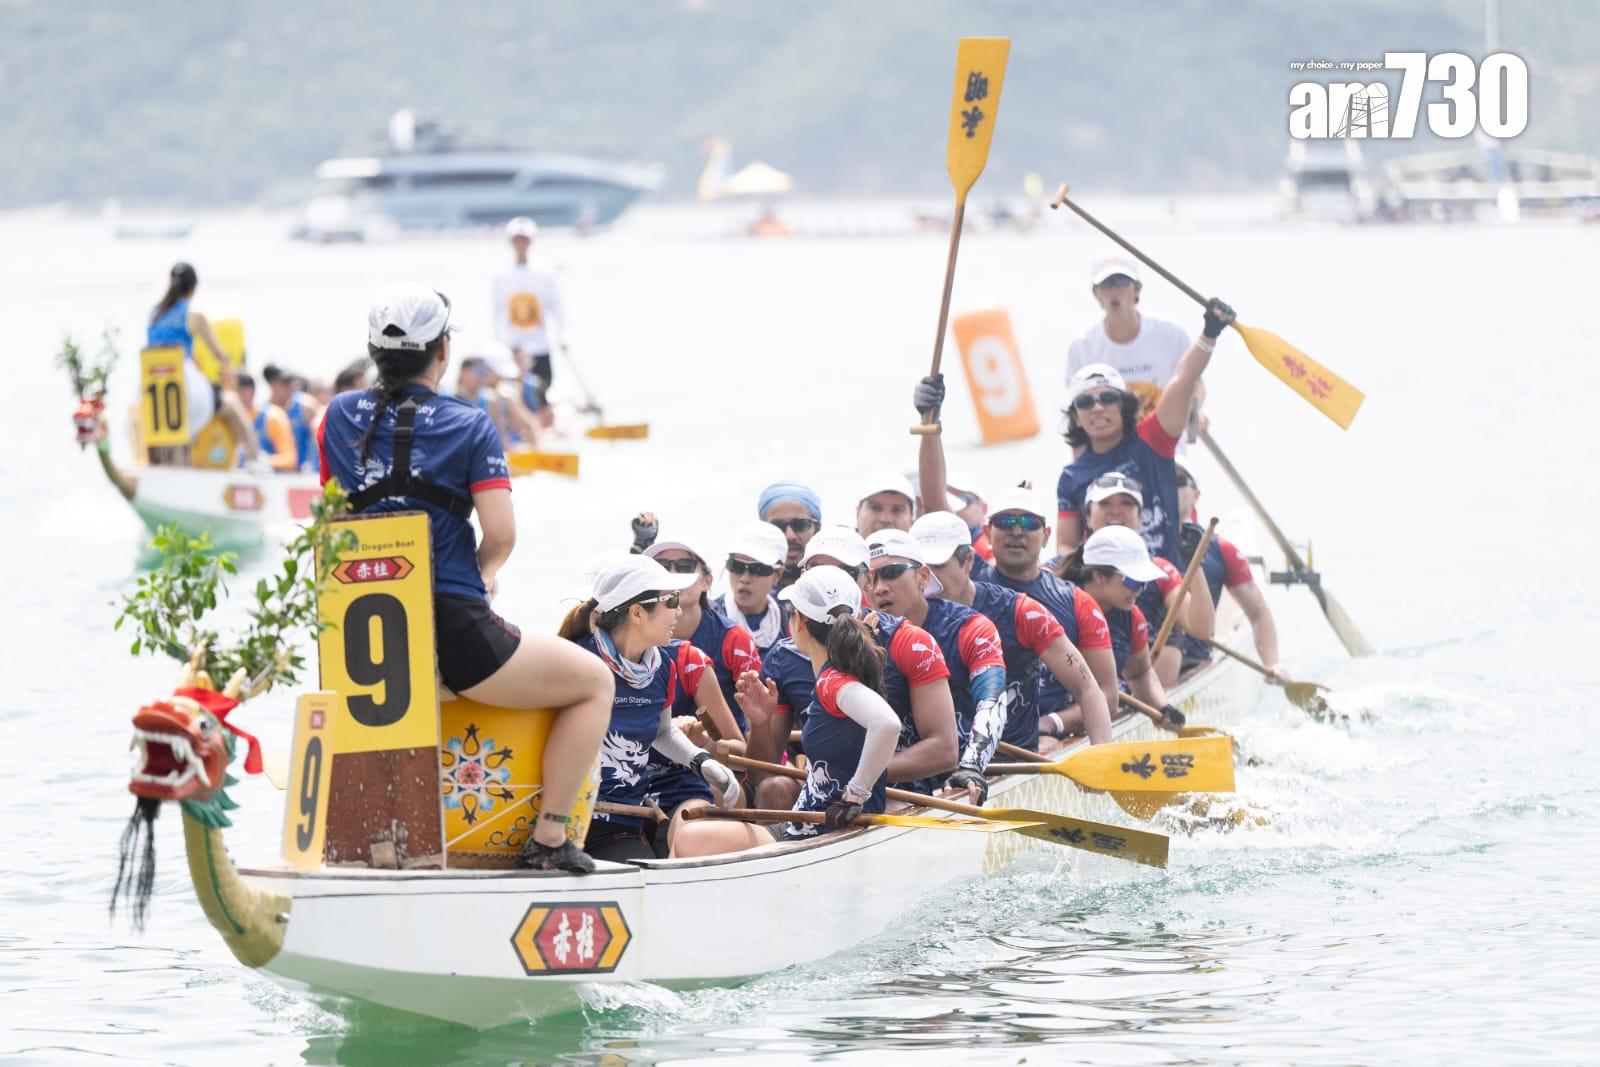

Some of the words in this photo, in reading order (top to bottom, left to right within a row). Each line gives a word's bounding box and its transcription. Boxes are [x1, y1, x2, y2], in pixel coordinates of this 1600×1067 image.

[145, 381, 182, 432] 10
[968, 334, 1019, 417] 9
[356, 561, 389, 579] 赤柱
[361, 542, 394, 552] Dragon
[395, 539, 415, 549] Boat
[343, 592, 412, 727] 9
[296, 736, 323, 853] 9
